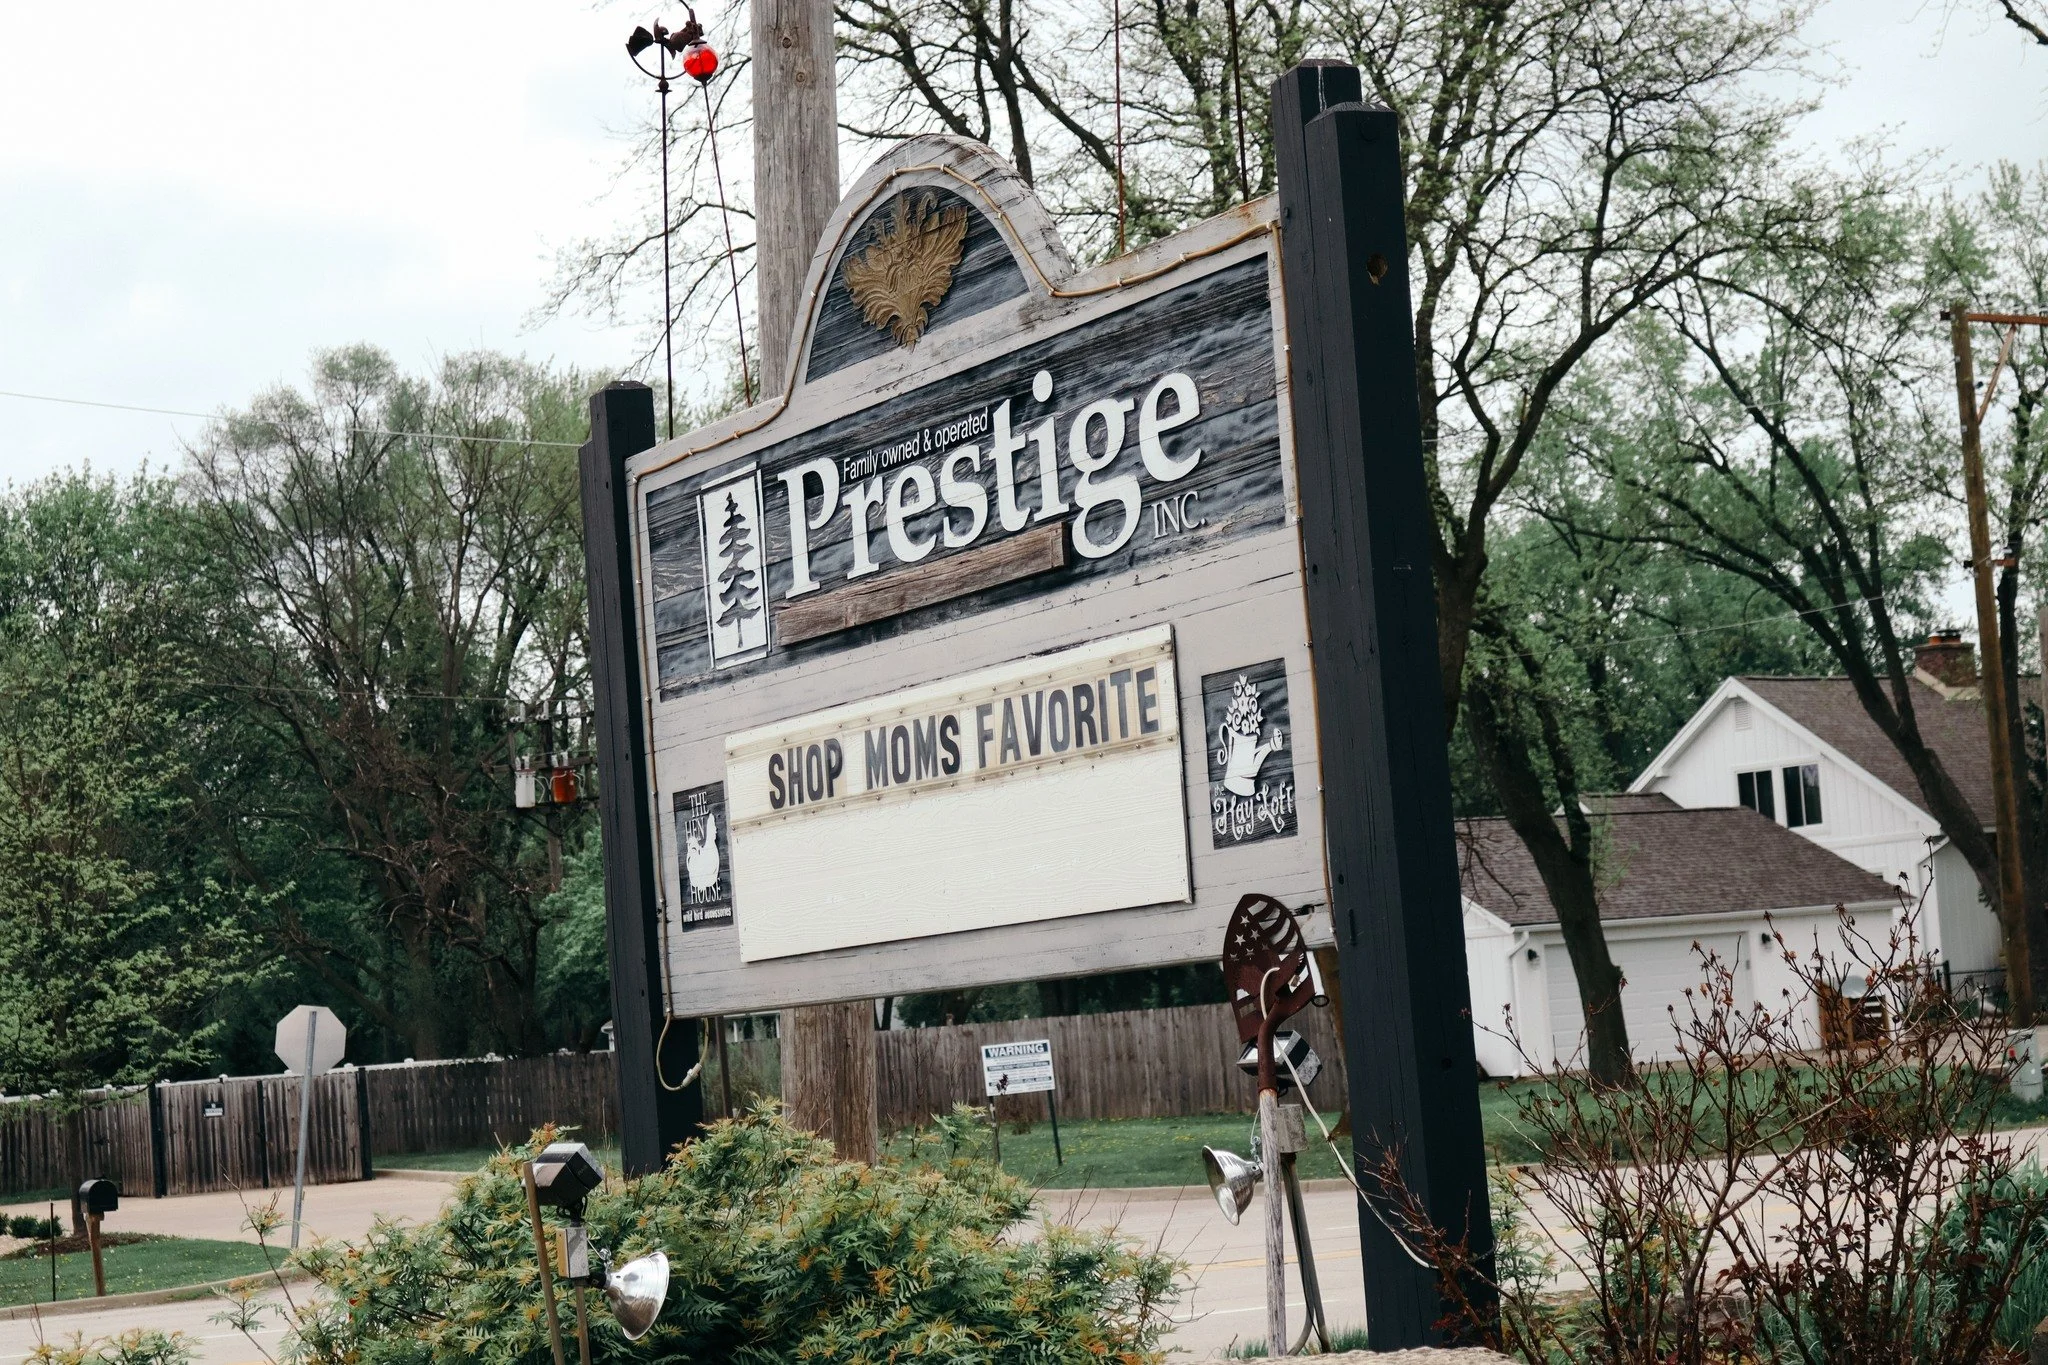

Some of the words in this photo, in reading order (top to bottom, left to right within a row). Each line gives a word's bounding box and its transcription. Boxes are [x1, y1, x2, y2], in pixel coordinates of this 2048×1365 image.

[843, 449, 879, 482] Family
[881, 432, 920, 467] owned
[923, 428, 932, 452] &
[934, 406, 989, 452] operated
[777, 370, 1202, 600] Prestige
[1152, 490, 1206, 539] INC.
[768, 737, 844, 810] SHOP
[865, 714, 961, 790] MOMS
[975, 667, 1159, 769] FAVORITE
[688, 791, 710, 818] THE
[1213, 795, 1254, 840] Hay
[684, 817, 706, 843] HEN
[690, 877, 722, 905] HOUSE
[987, 1043, 1045, 1058] WARNING
